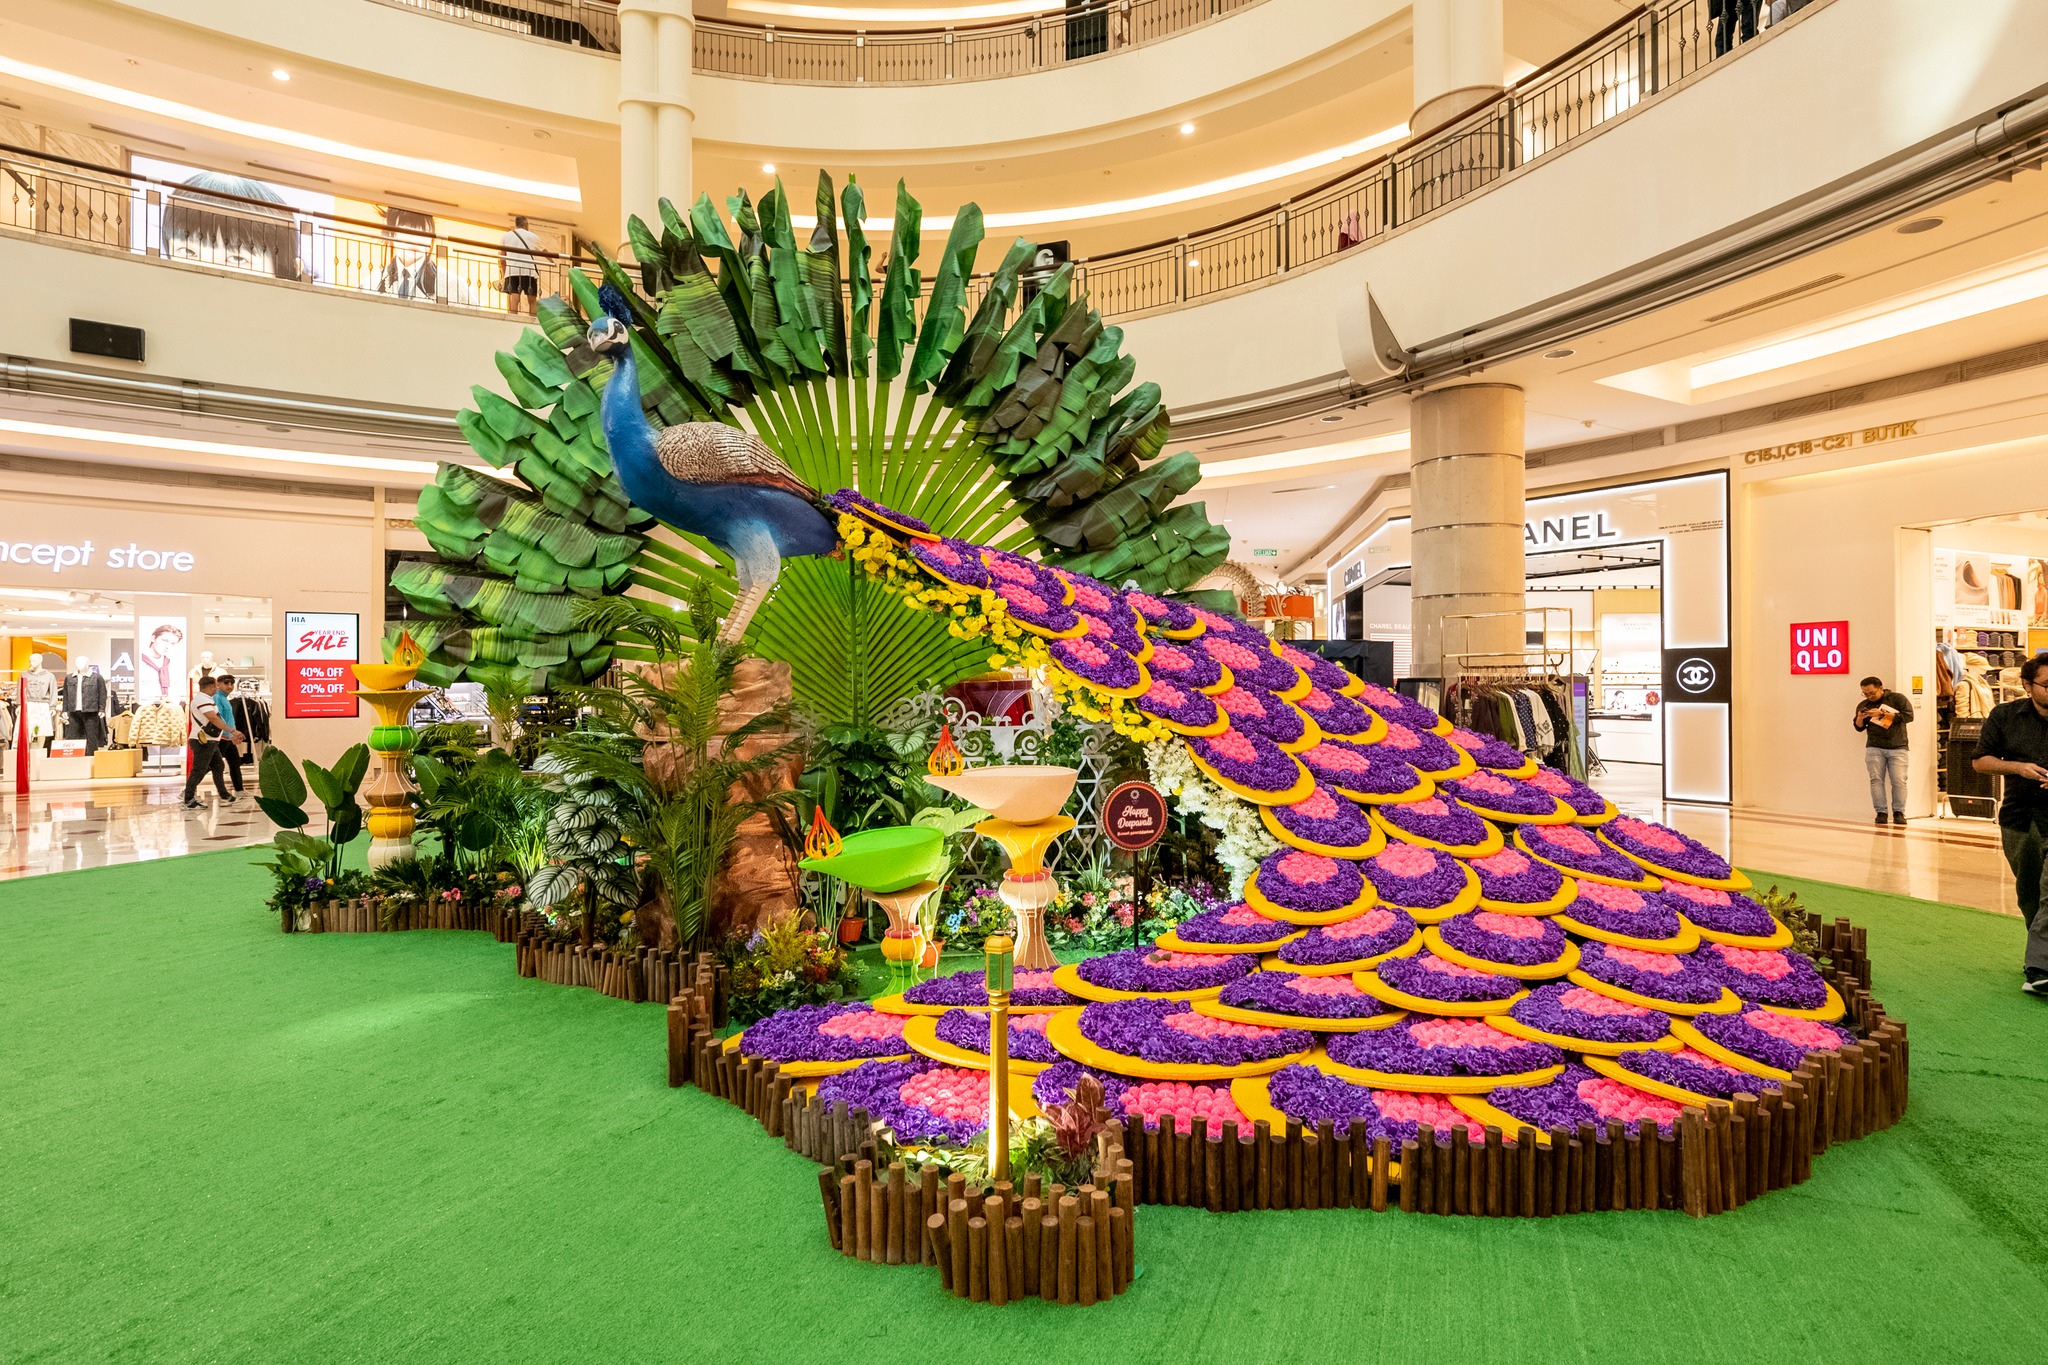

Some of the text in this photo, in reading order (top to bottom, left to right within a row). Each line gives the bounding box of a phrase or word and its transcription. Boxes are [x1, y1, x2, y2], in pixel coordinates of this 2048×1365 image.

[1862, 420, 1918, 444] BUTIK
[106, 543, 195, 572] store
[296, 631, 349, 653] SALE
[1796, 627, 1837, 647] UNI
[1796, 649, 1842, 672] QLO
[300, 667, 344, 677] 40% OFF
[300, 683, 345, 694] 20% OFF
[1122, 805, 1149, 818] Happy
[1117, 816, 1153, 829] Deepavali
